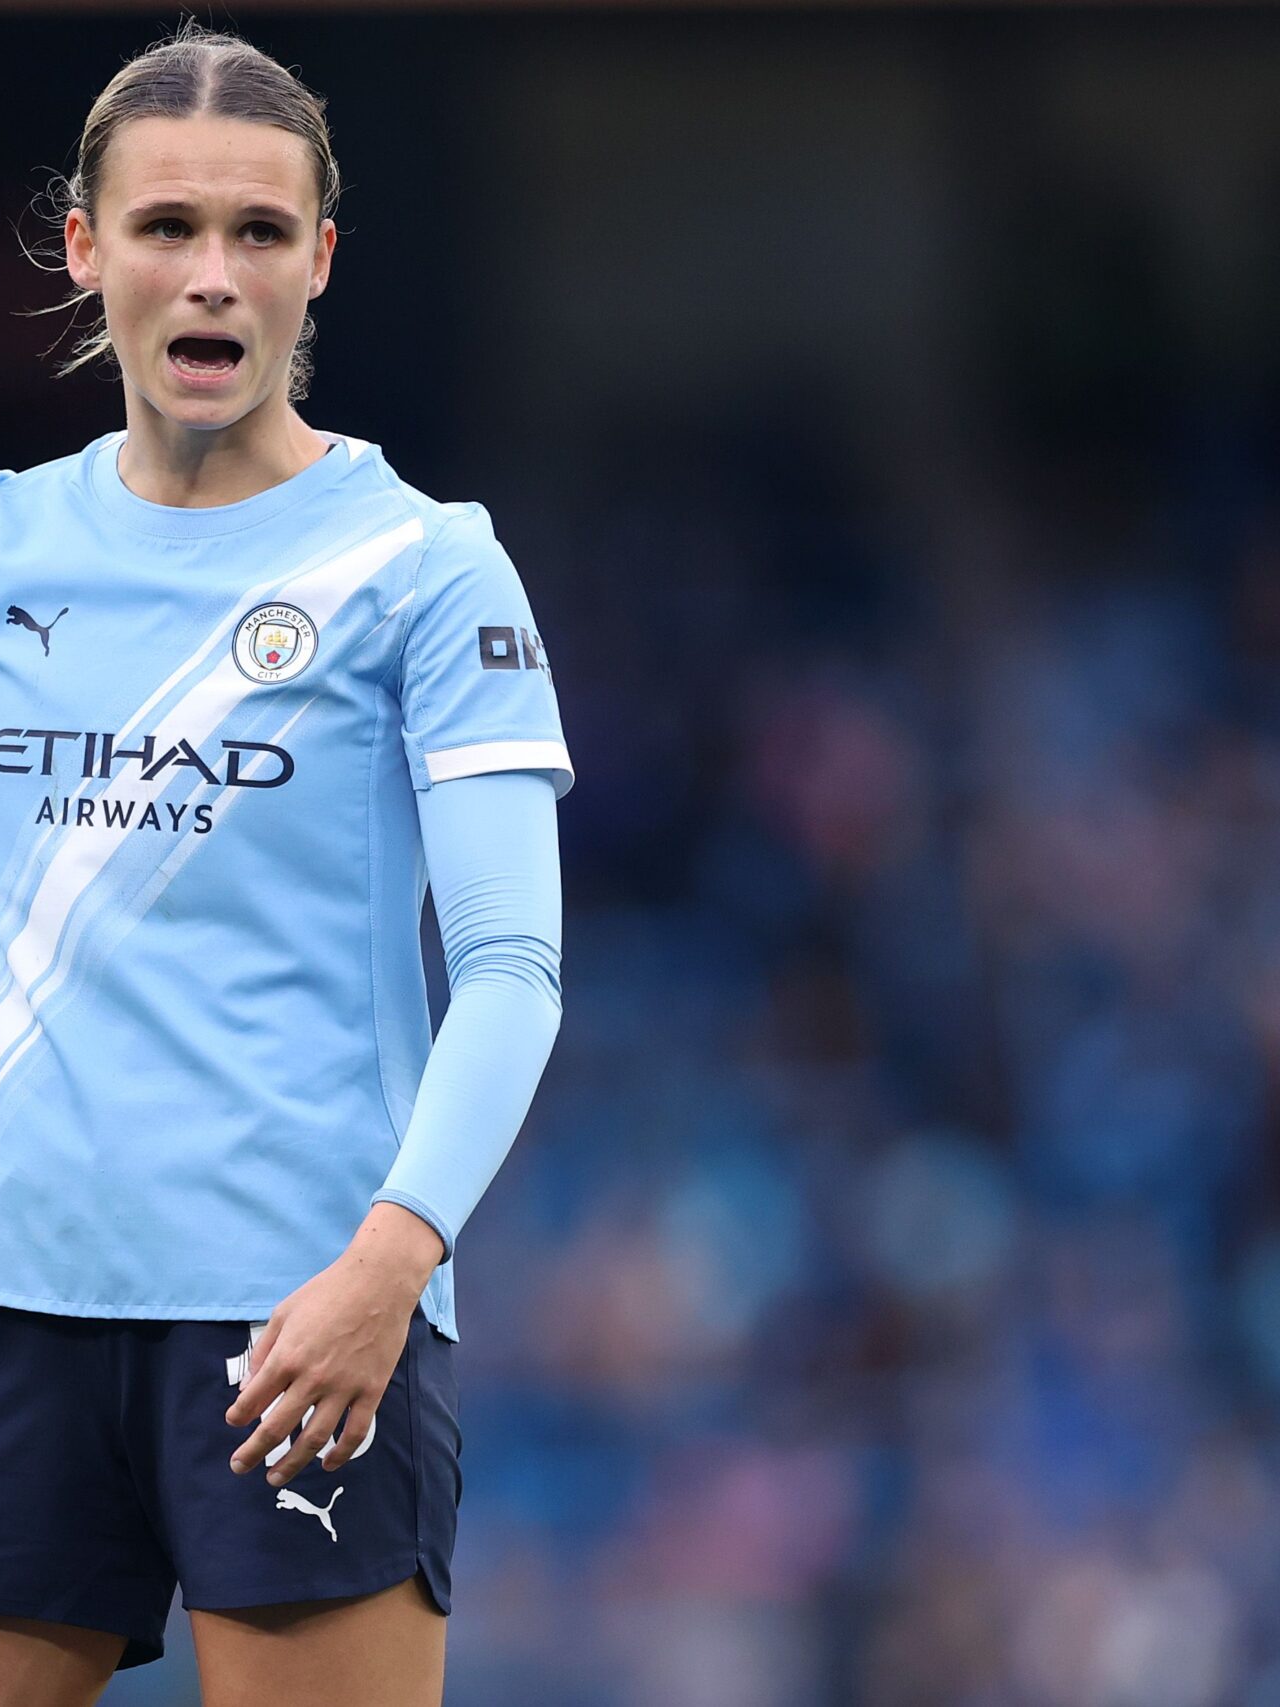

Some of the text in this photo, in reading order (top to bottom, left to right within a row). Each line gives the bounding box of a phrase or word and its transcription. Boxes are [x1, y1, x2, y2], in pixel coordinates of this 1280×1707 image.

[245, 609, 311, 638] MANCHESTER
[257, 671, 282, 679] CITY
[35, 796, 213, 834] AIRWAYS
